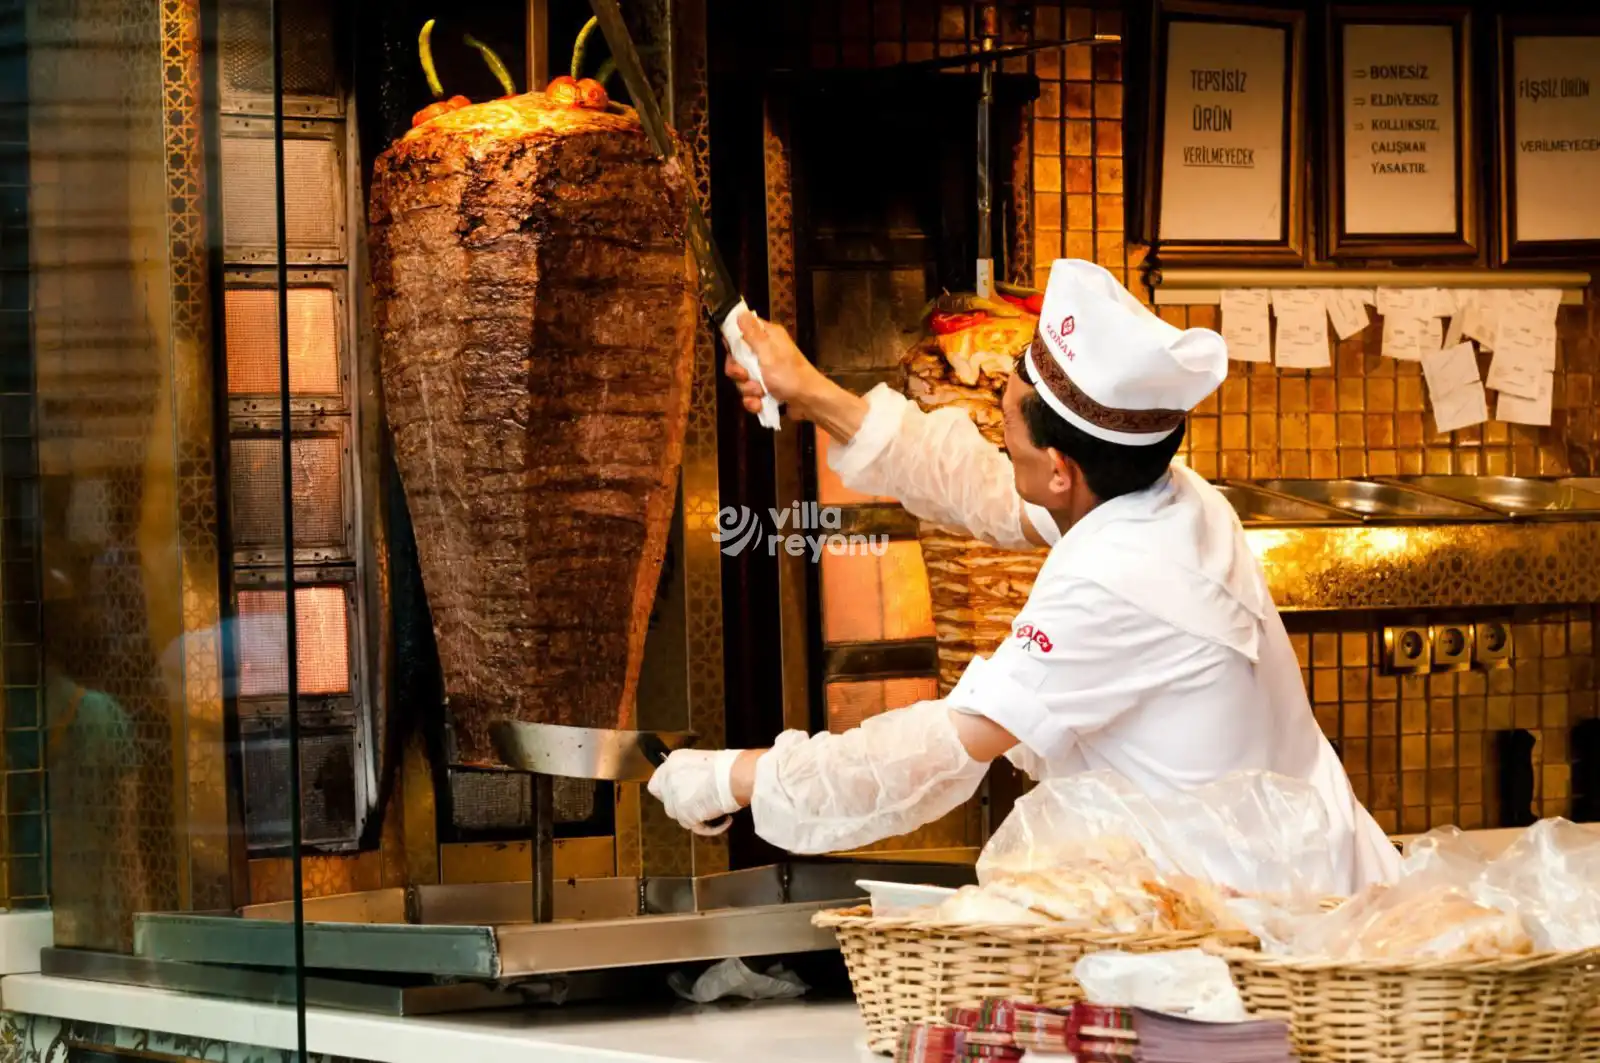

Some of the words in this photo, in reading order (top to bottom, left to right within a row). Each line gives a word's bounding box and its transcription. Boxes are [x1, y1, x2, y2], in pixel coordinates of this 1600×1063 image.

[1190, 69, 1247, 93] TEPSİSİZ
[1370, 63, 1429, 80] BONESİZ
[1193, 104, 1232, 132] ÜRÜN
[1183, 145, 1255, 165] VERİLMEYECEK
